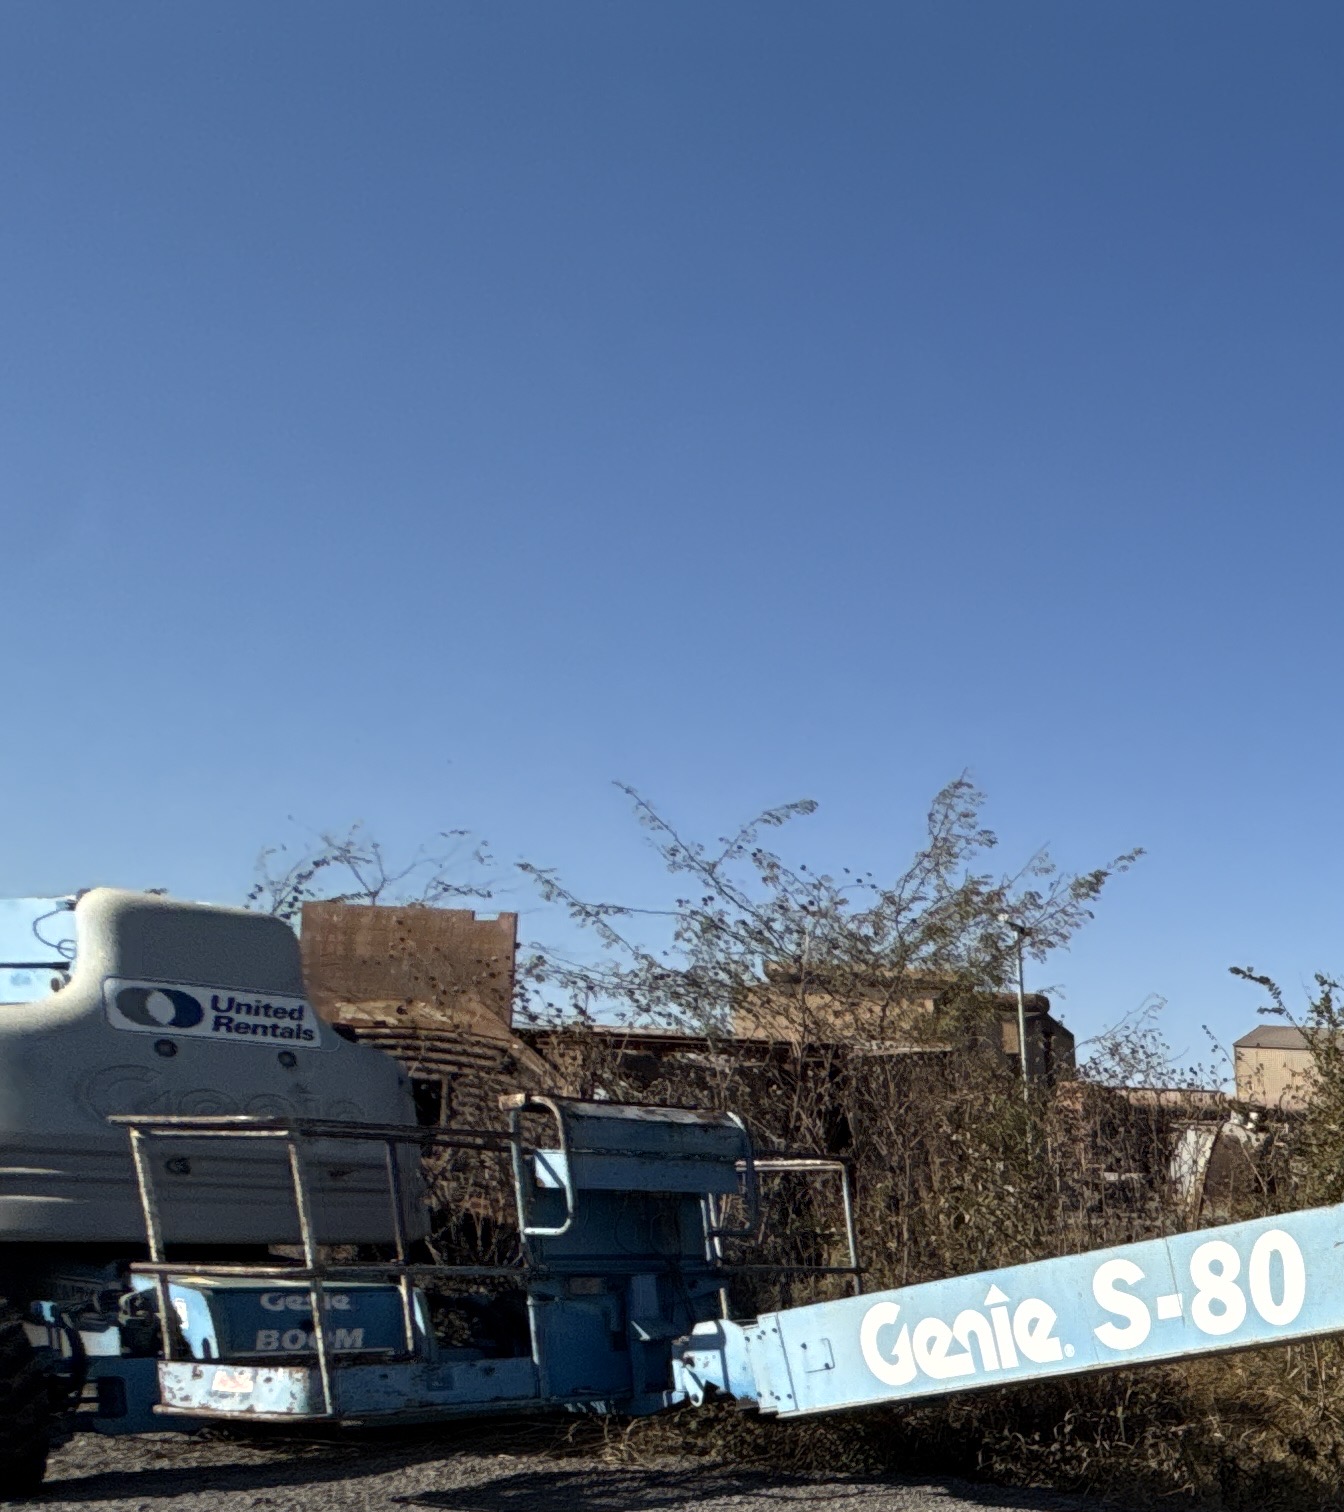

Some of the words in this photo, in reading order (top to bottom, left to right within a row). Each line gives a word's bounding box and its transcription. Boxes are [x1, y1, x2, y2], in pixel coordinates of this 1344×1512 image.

[210, 994, 305, 1021] United
[212, 1015, 315, 1042] Rentals
[259, 1292, 352, 1312] Geie
[859, 1284, 1063, 1386] Genie
[1092, 1229, 1306, 1351] S-80
